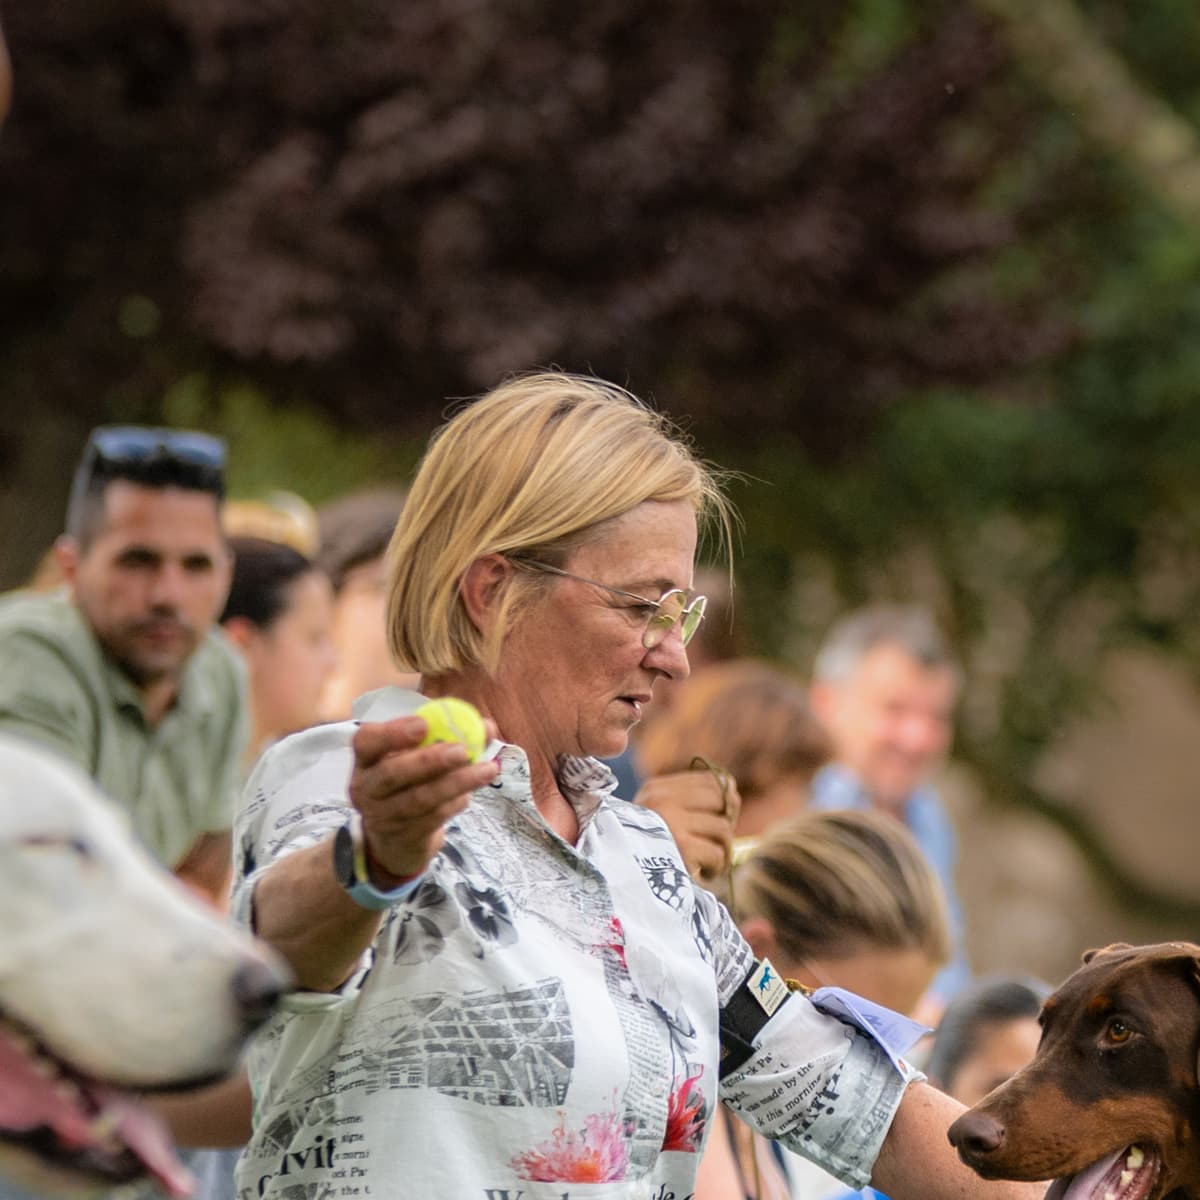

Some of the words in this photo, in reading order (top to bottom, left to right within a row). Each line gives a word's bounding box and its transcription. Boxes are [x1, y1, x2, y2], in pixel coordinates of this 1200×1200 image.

[782, 1076, 798, 1091] by
[797, 1061, 815, 1078] the
[766, 1107, 784, 1122] this
